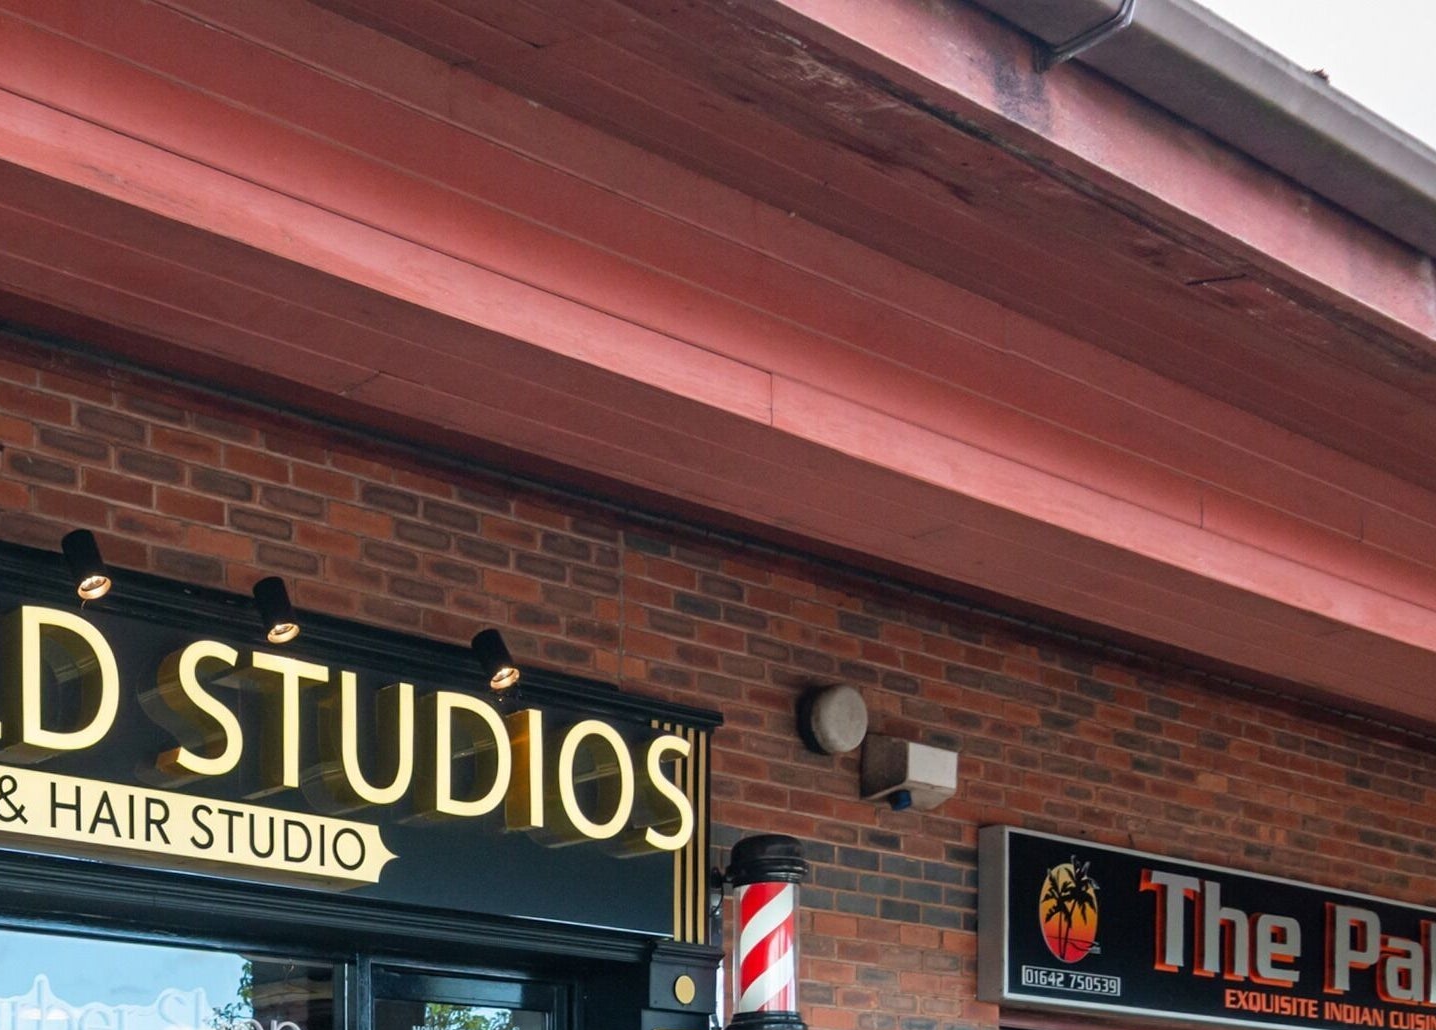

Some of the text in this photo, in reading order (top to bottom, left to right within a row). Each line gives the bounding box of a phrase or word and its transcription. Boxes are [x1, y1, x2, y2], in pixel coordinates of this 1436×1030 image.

[176, 640, 694, 851] STUDIOS
[49, 782, 173, 845] HAIR
[189, 804, 368, 871] STUDIO
[1141, 869, 1302, 985] The
[1025, 968, 1117, 994] 01642 750539
[1225, 988, 1318, 1019] EXQUISITE
[1324, 1001, 1385, 1028] INDIAN
